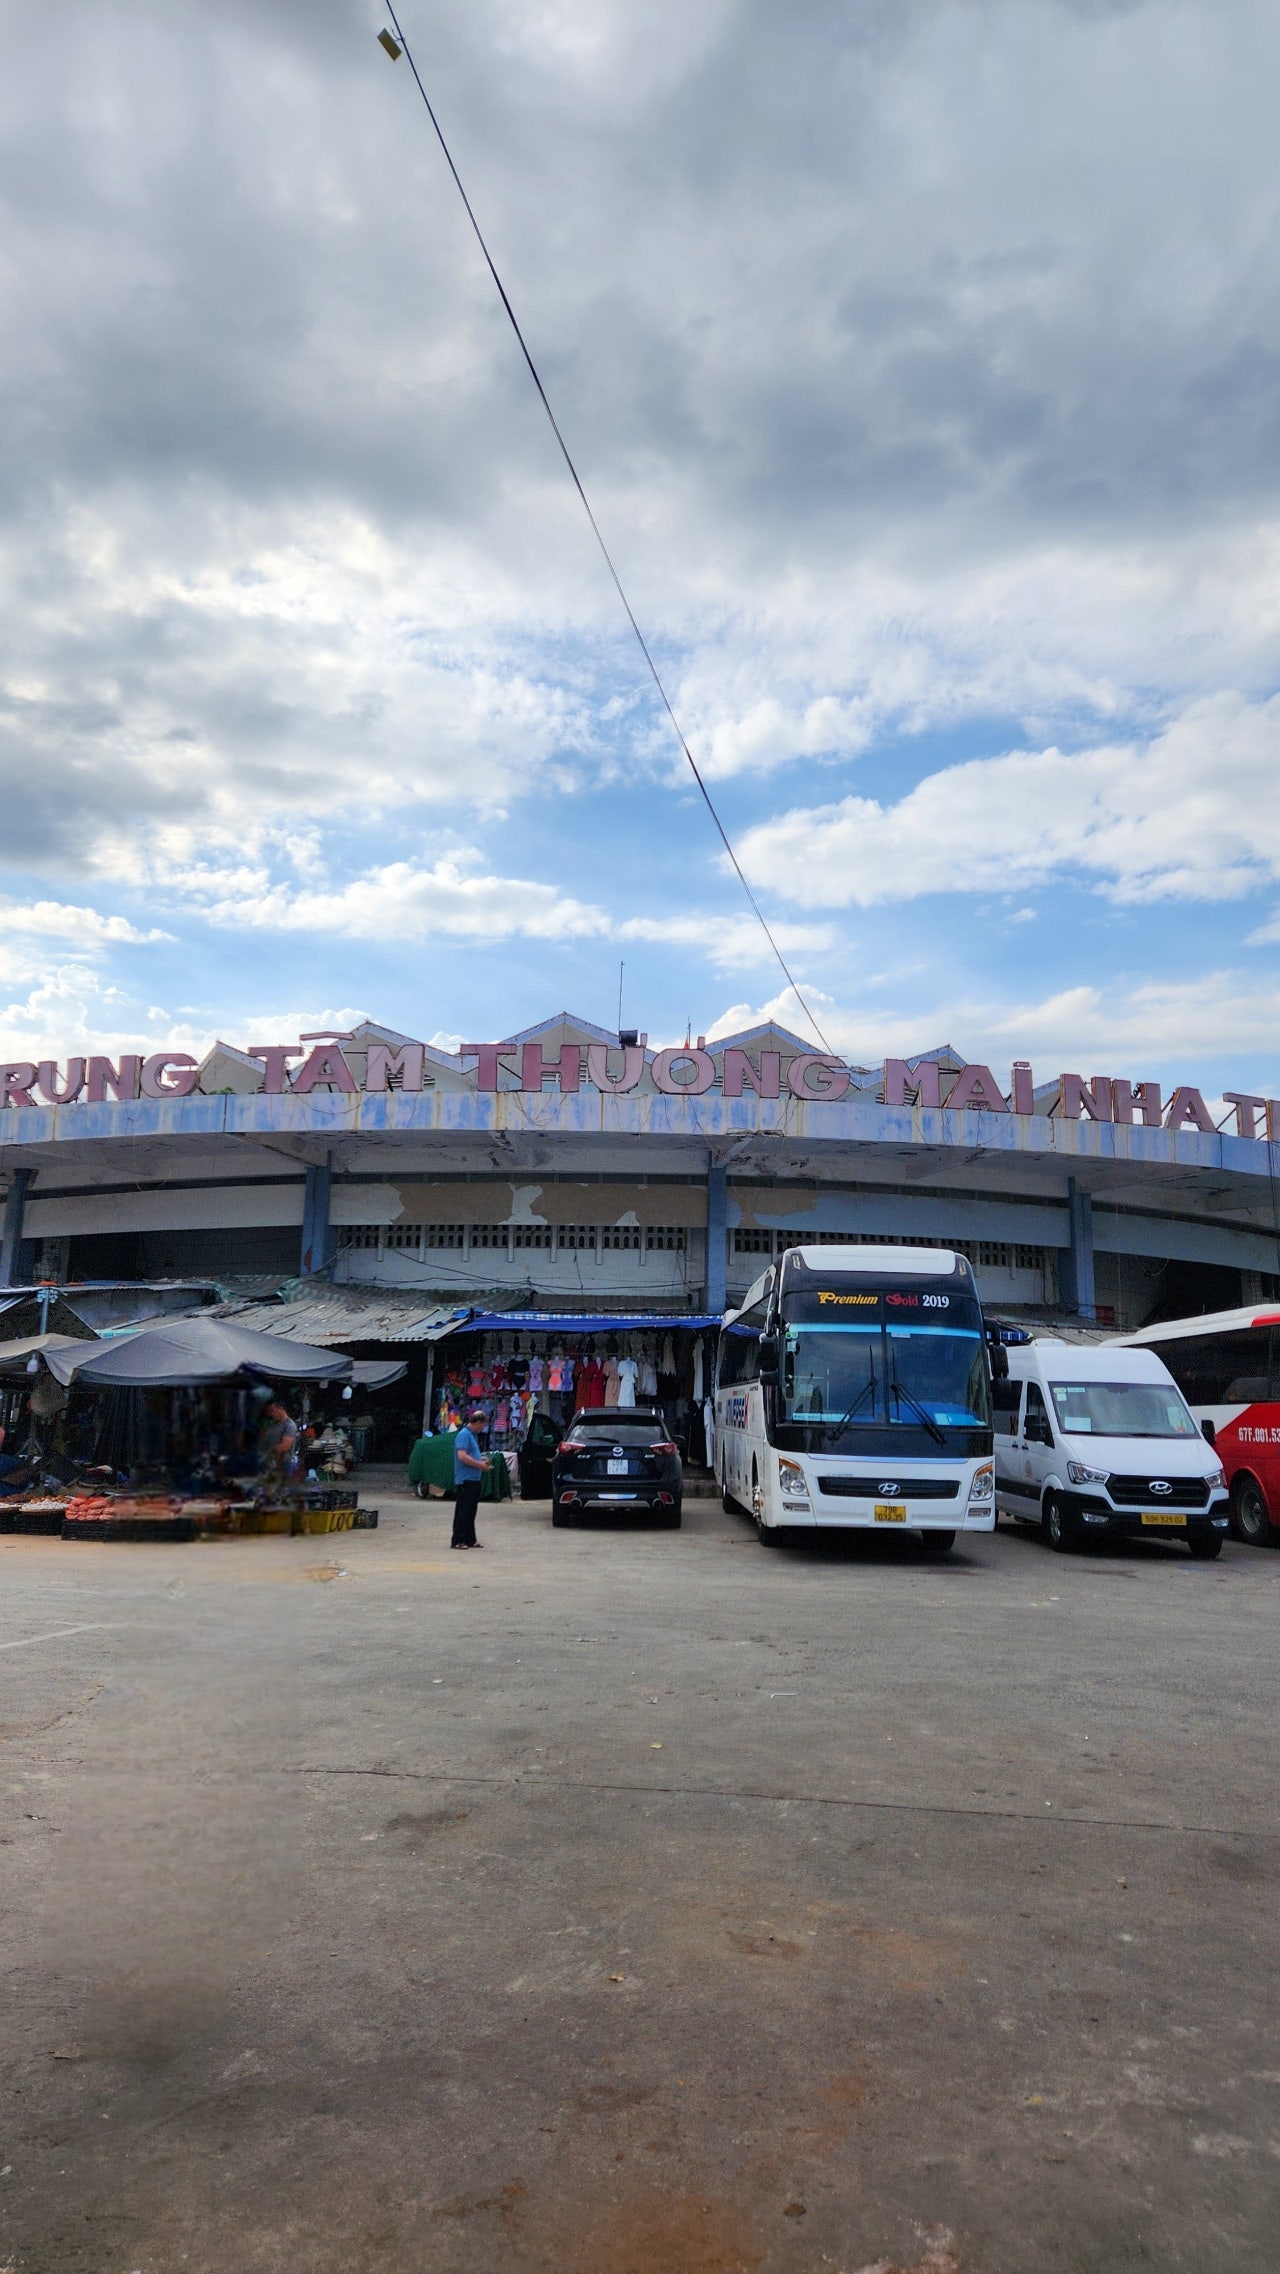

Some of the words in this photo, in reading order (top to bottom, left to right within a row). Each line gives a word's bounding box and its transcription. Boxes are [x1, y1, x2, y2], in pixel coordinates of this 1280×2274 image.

[0, 1053, 199, 1108] RUNG
[817, 1292, 879, 1305] Premium
[922, 1294, 950, 1308] 2019
